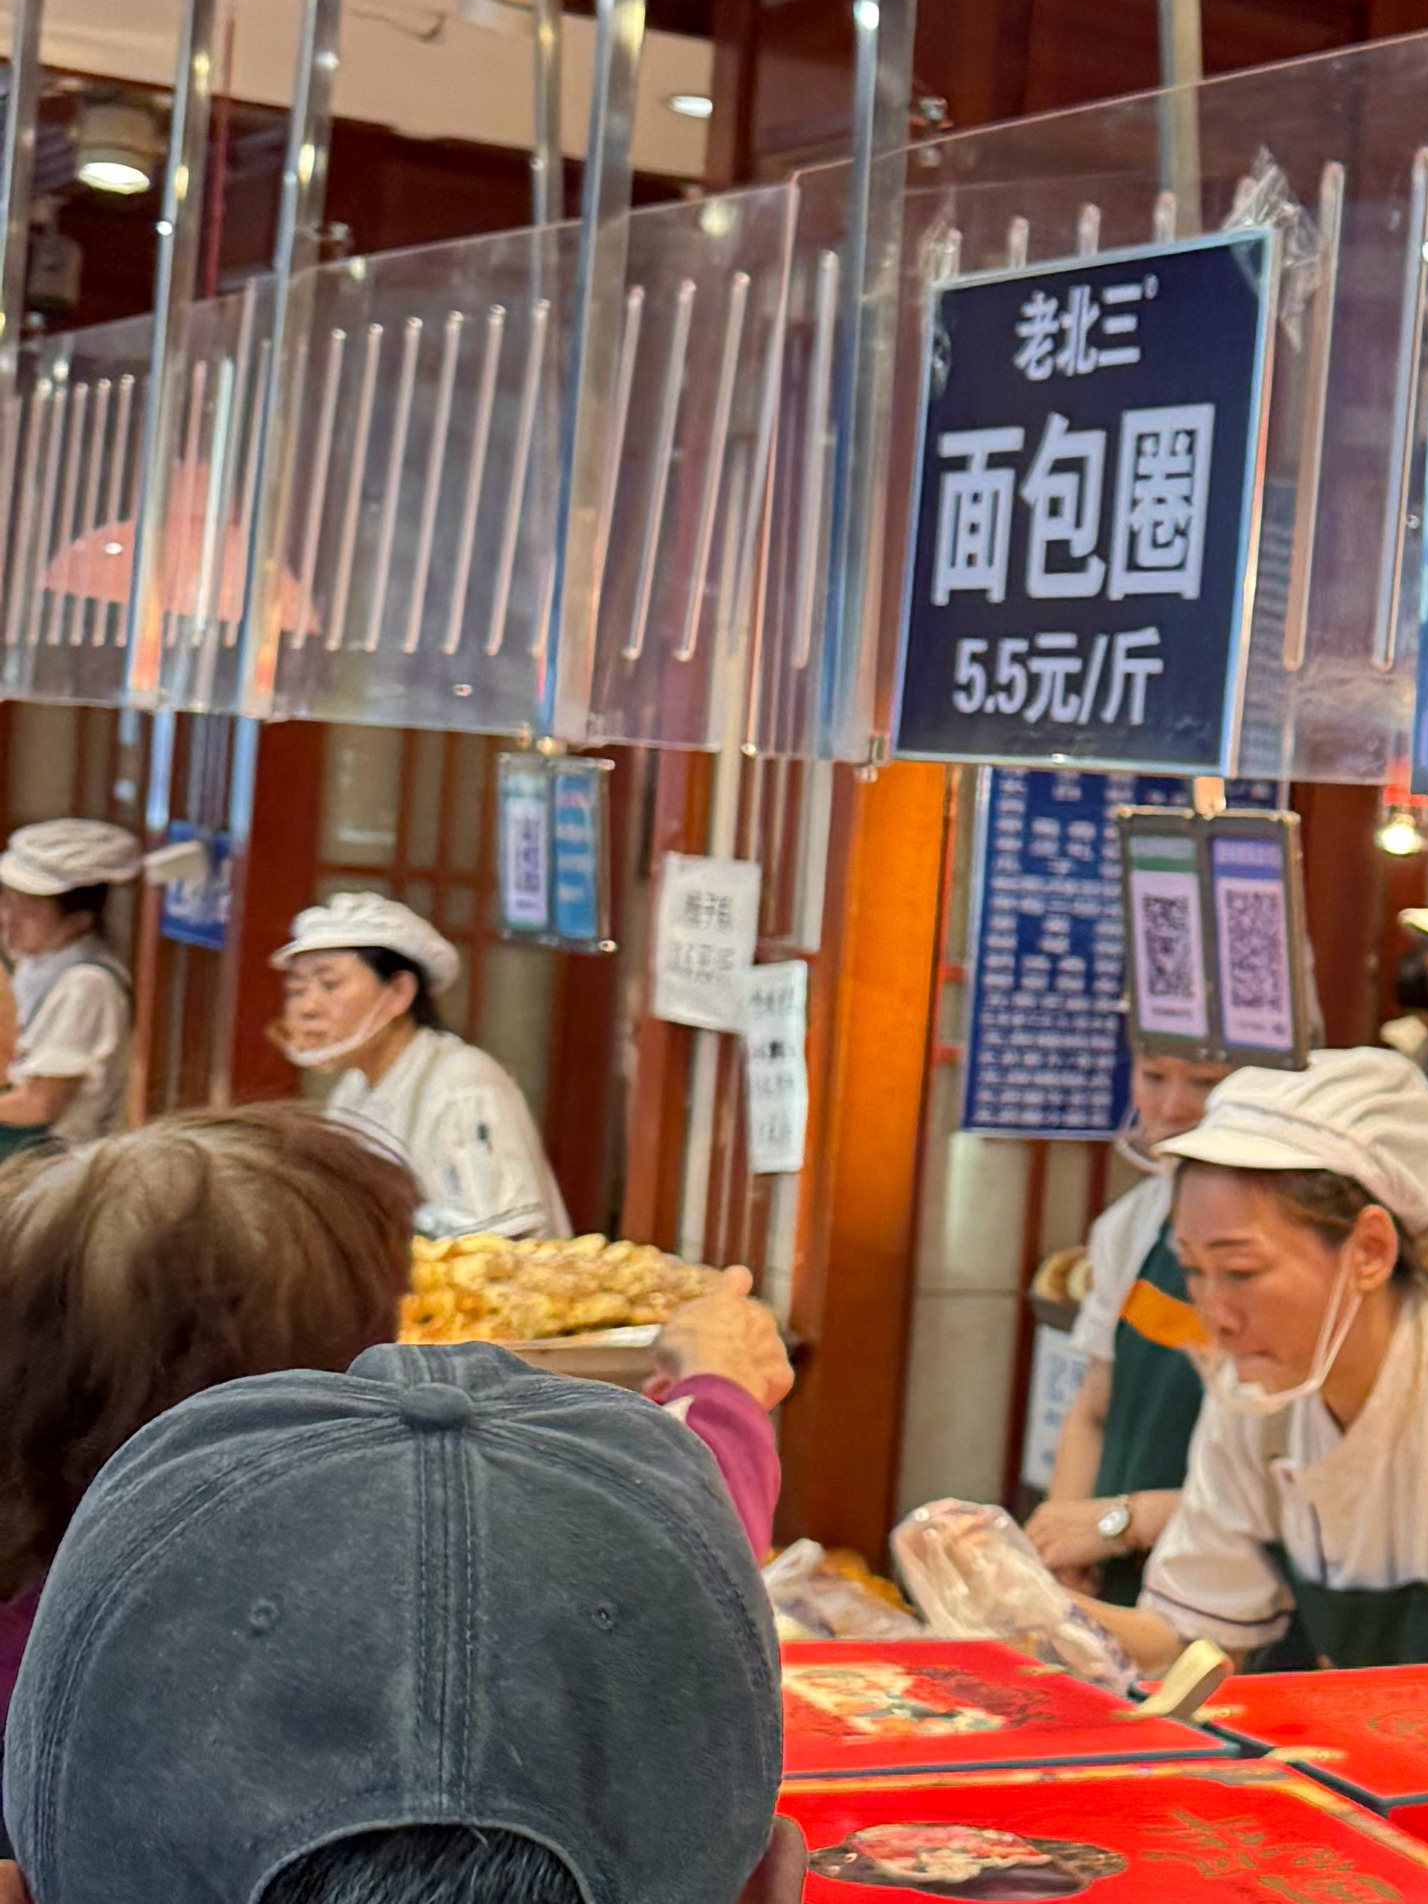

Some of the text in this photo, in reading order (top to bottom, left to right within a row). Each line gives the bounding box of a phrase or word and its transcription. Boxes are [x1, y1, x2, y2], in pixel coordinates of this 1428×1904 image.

[931, 402, 1216, 607] 面包圈
[953, 626, 1164, 726] 5.5元/斤
